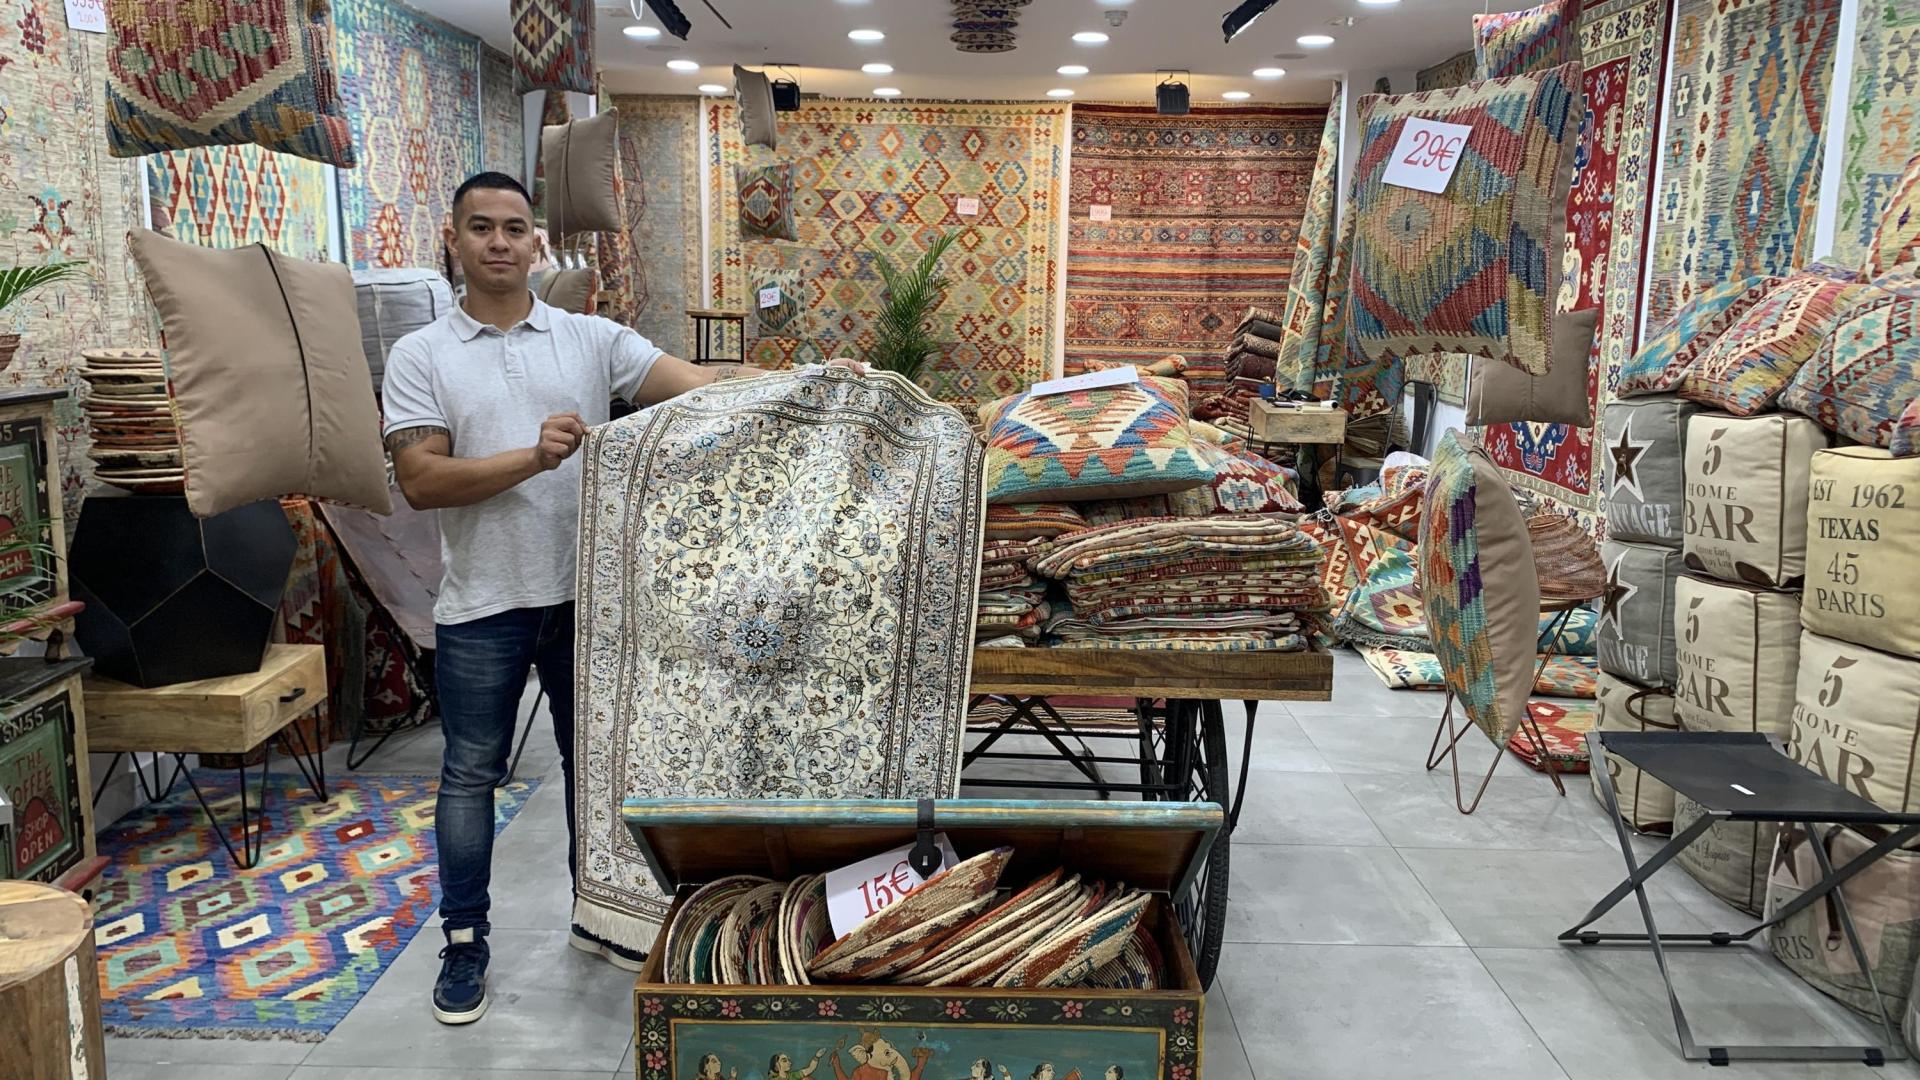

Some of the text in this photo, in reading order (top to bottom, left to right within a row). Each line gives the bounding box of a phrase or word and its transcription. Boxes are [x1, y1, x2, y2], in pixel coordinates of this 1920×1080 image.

[1403, 129, 1463, 172] 29€
[1702, 427, 1729, 476] 5
[1688, 482, 1737, 500] HOME
[1814, 479, 1905, 509] EST 1962
[1685, 499, 1760, 544] BAR
[1818, 517, 1880, 542] TEXAS
[1827, 552, 1860, 585] 45
[1685, 597, 1704, 644] 5
[1816, 587, 1886, 619] PARIS
[1818, 655, 1859, 708] 5
[1788, 720, 1877, 803] BAR
[21, 830, 53, 864] OPEN
[857, 860, 914, 919] 15€
